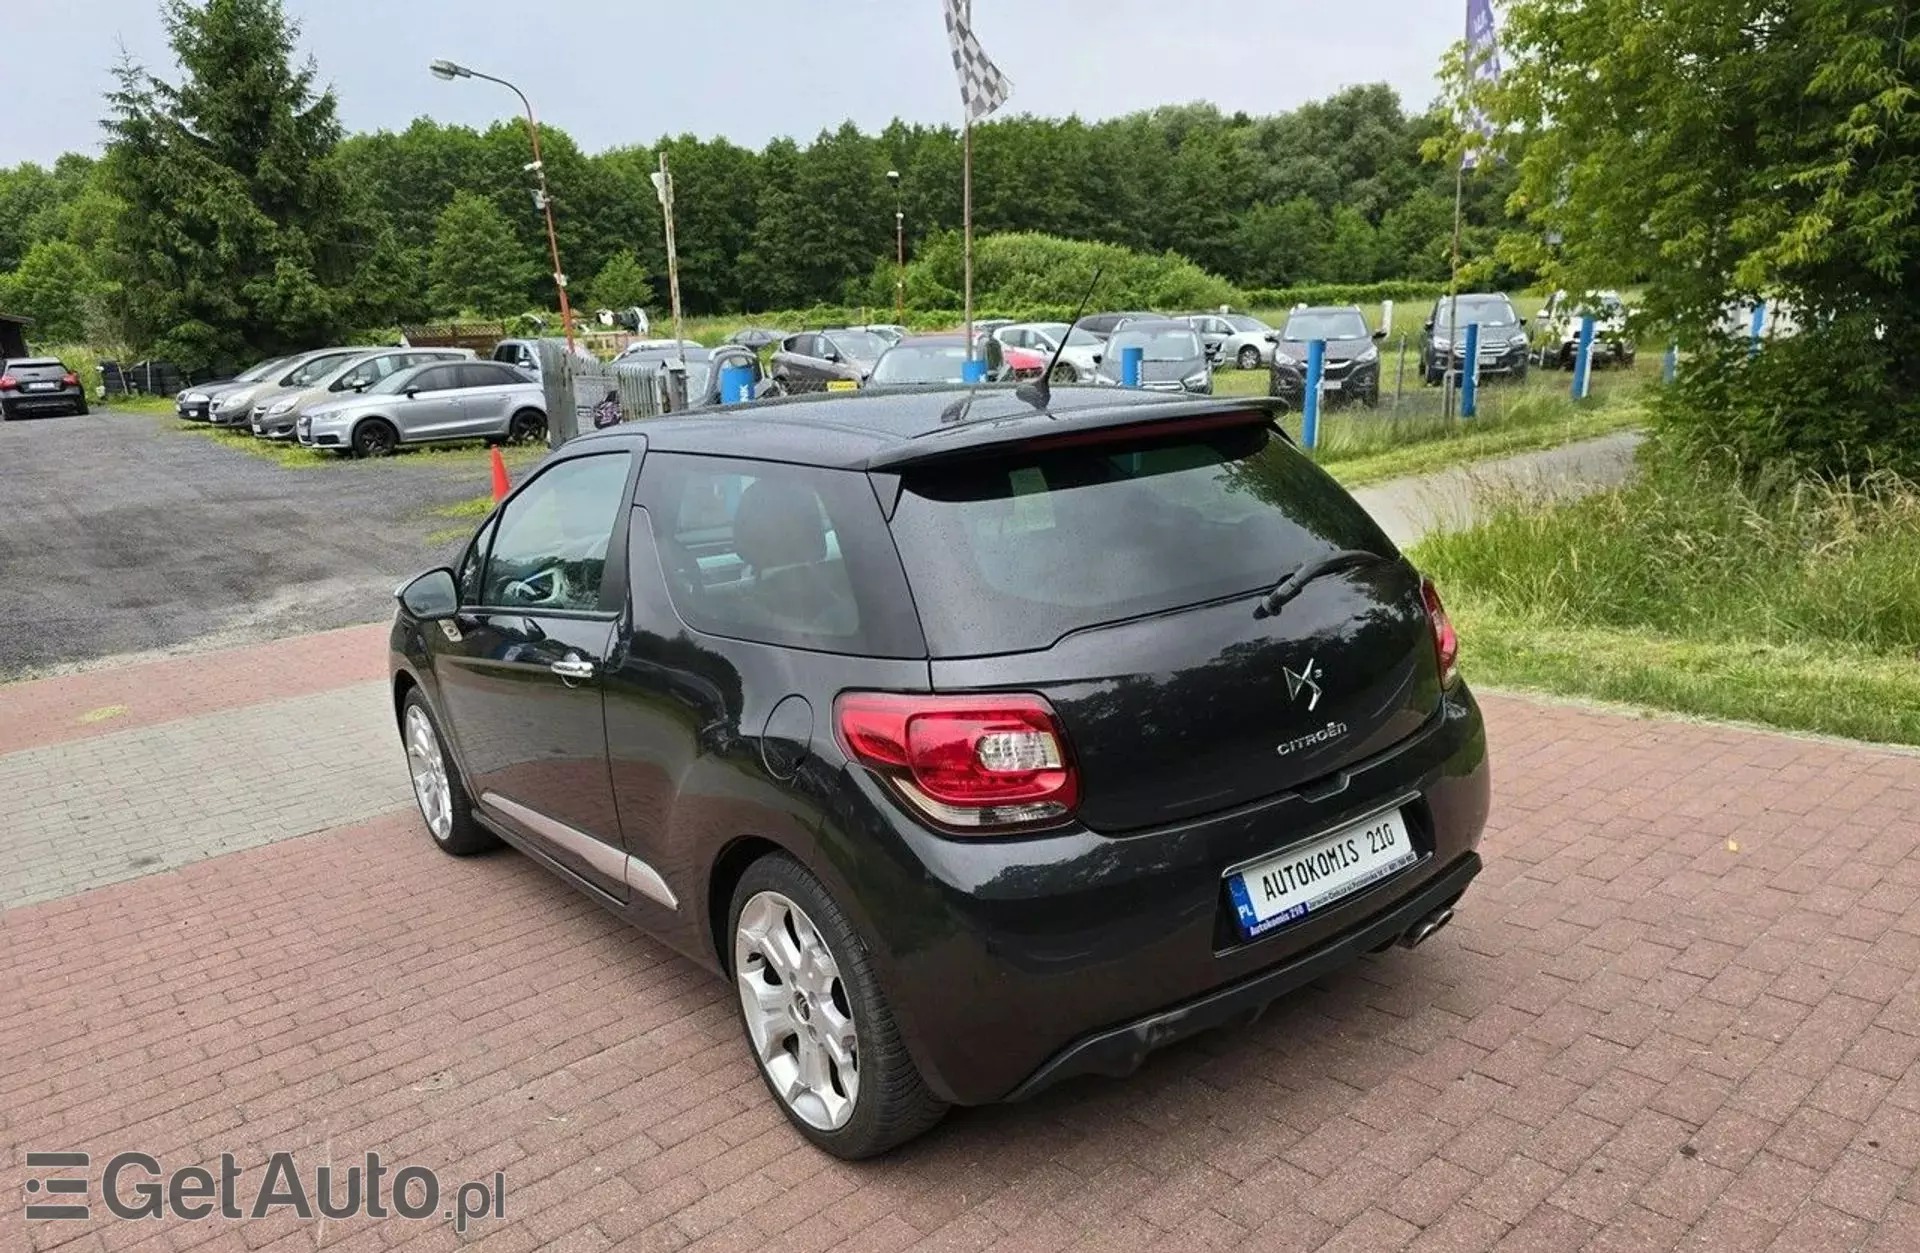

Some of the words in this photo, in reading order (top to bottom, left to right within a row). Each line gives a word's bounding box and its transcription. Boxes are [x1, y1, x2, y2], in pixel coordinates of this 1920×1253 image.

[1261, 839, 1359, 901] AUTOKOMIS
[1366, 822, 1395, 854] 210
[1237, 903, 1253, 919] PL
